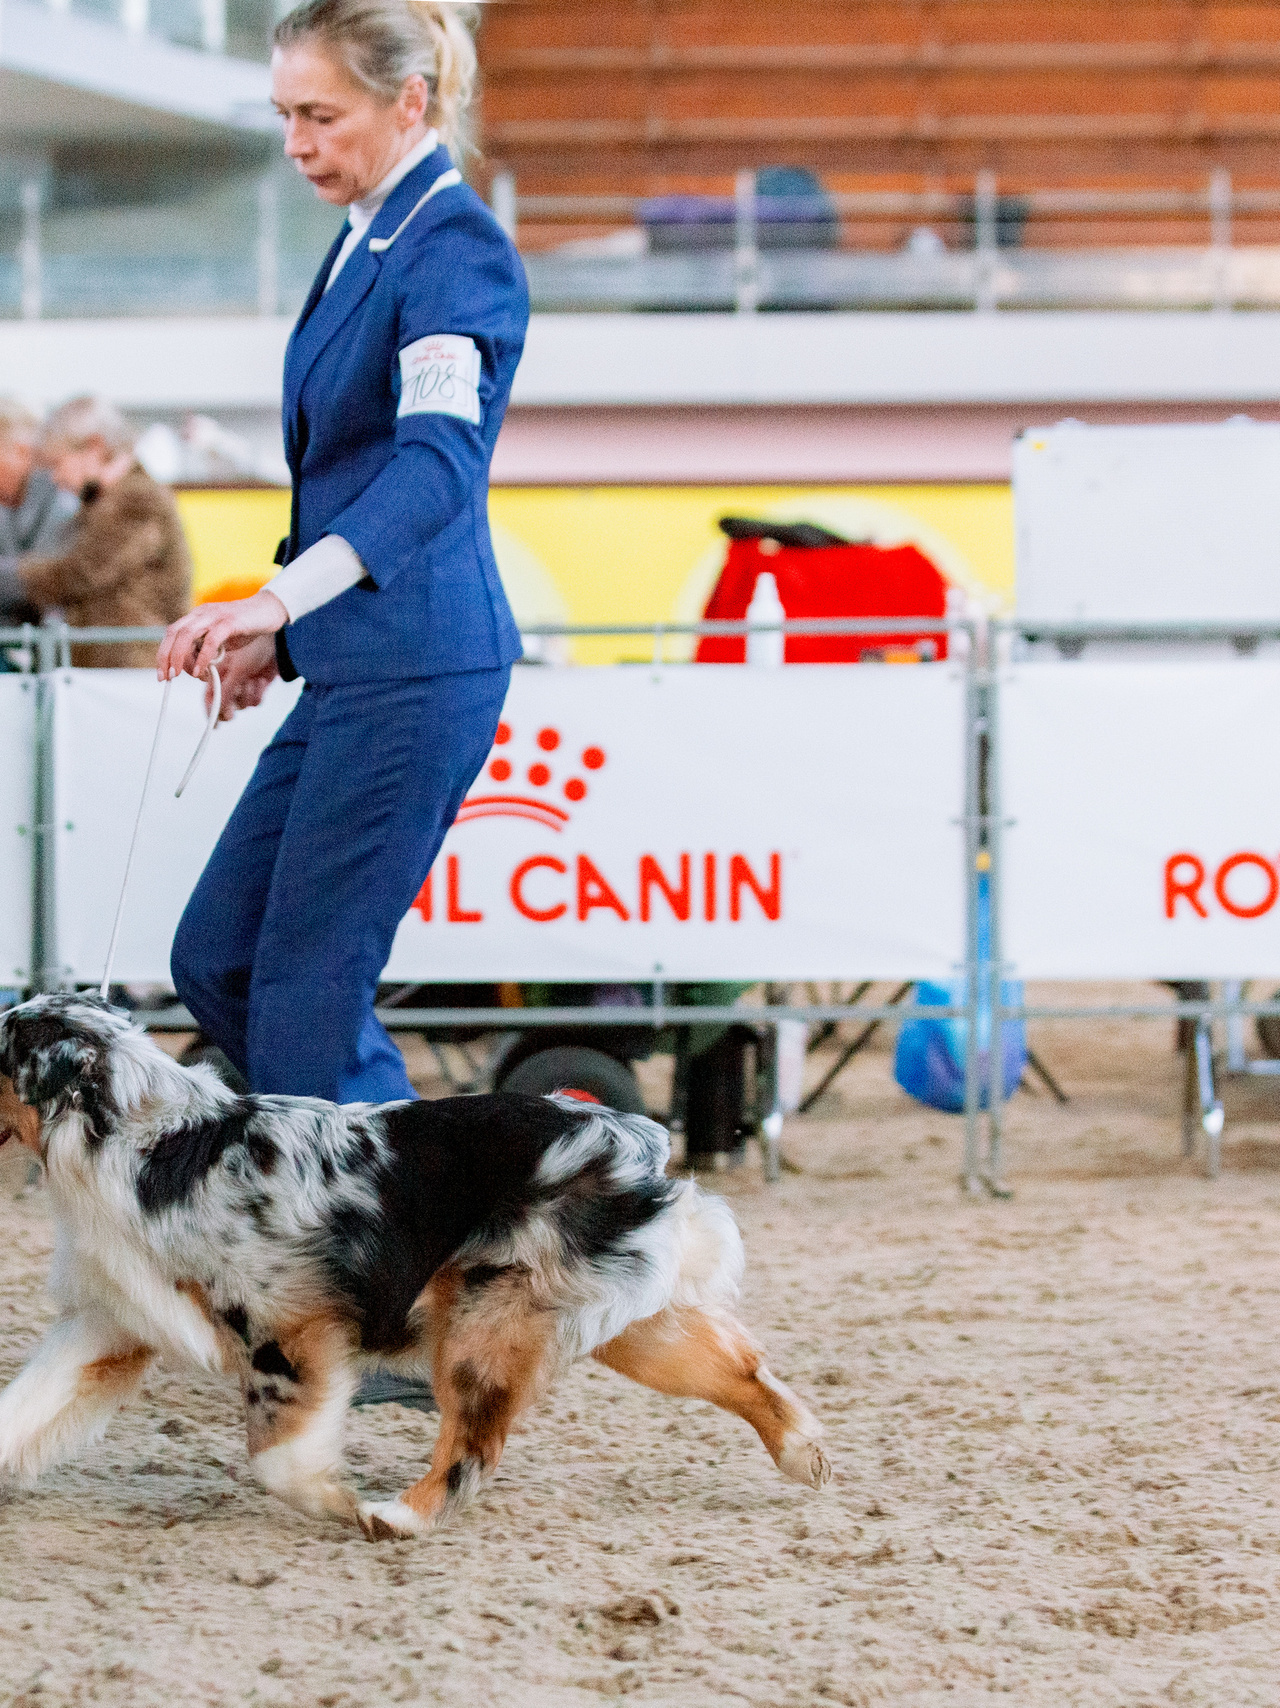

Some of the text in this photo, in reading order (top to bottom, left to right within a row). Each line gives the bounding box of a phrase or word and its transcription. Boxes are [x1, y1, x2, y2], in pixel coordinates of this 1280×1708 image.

[407, 362, 456, 407] 108
[509, 852, 781, 923] CANIN
[1164, 852, 1280, 920] RO
